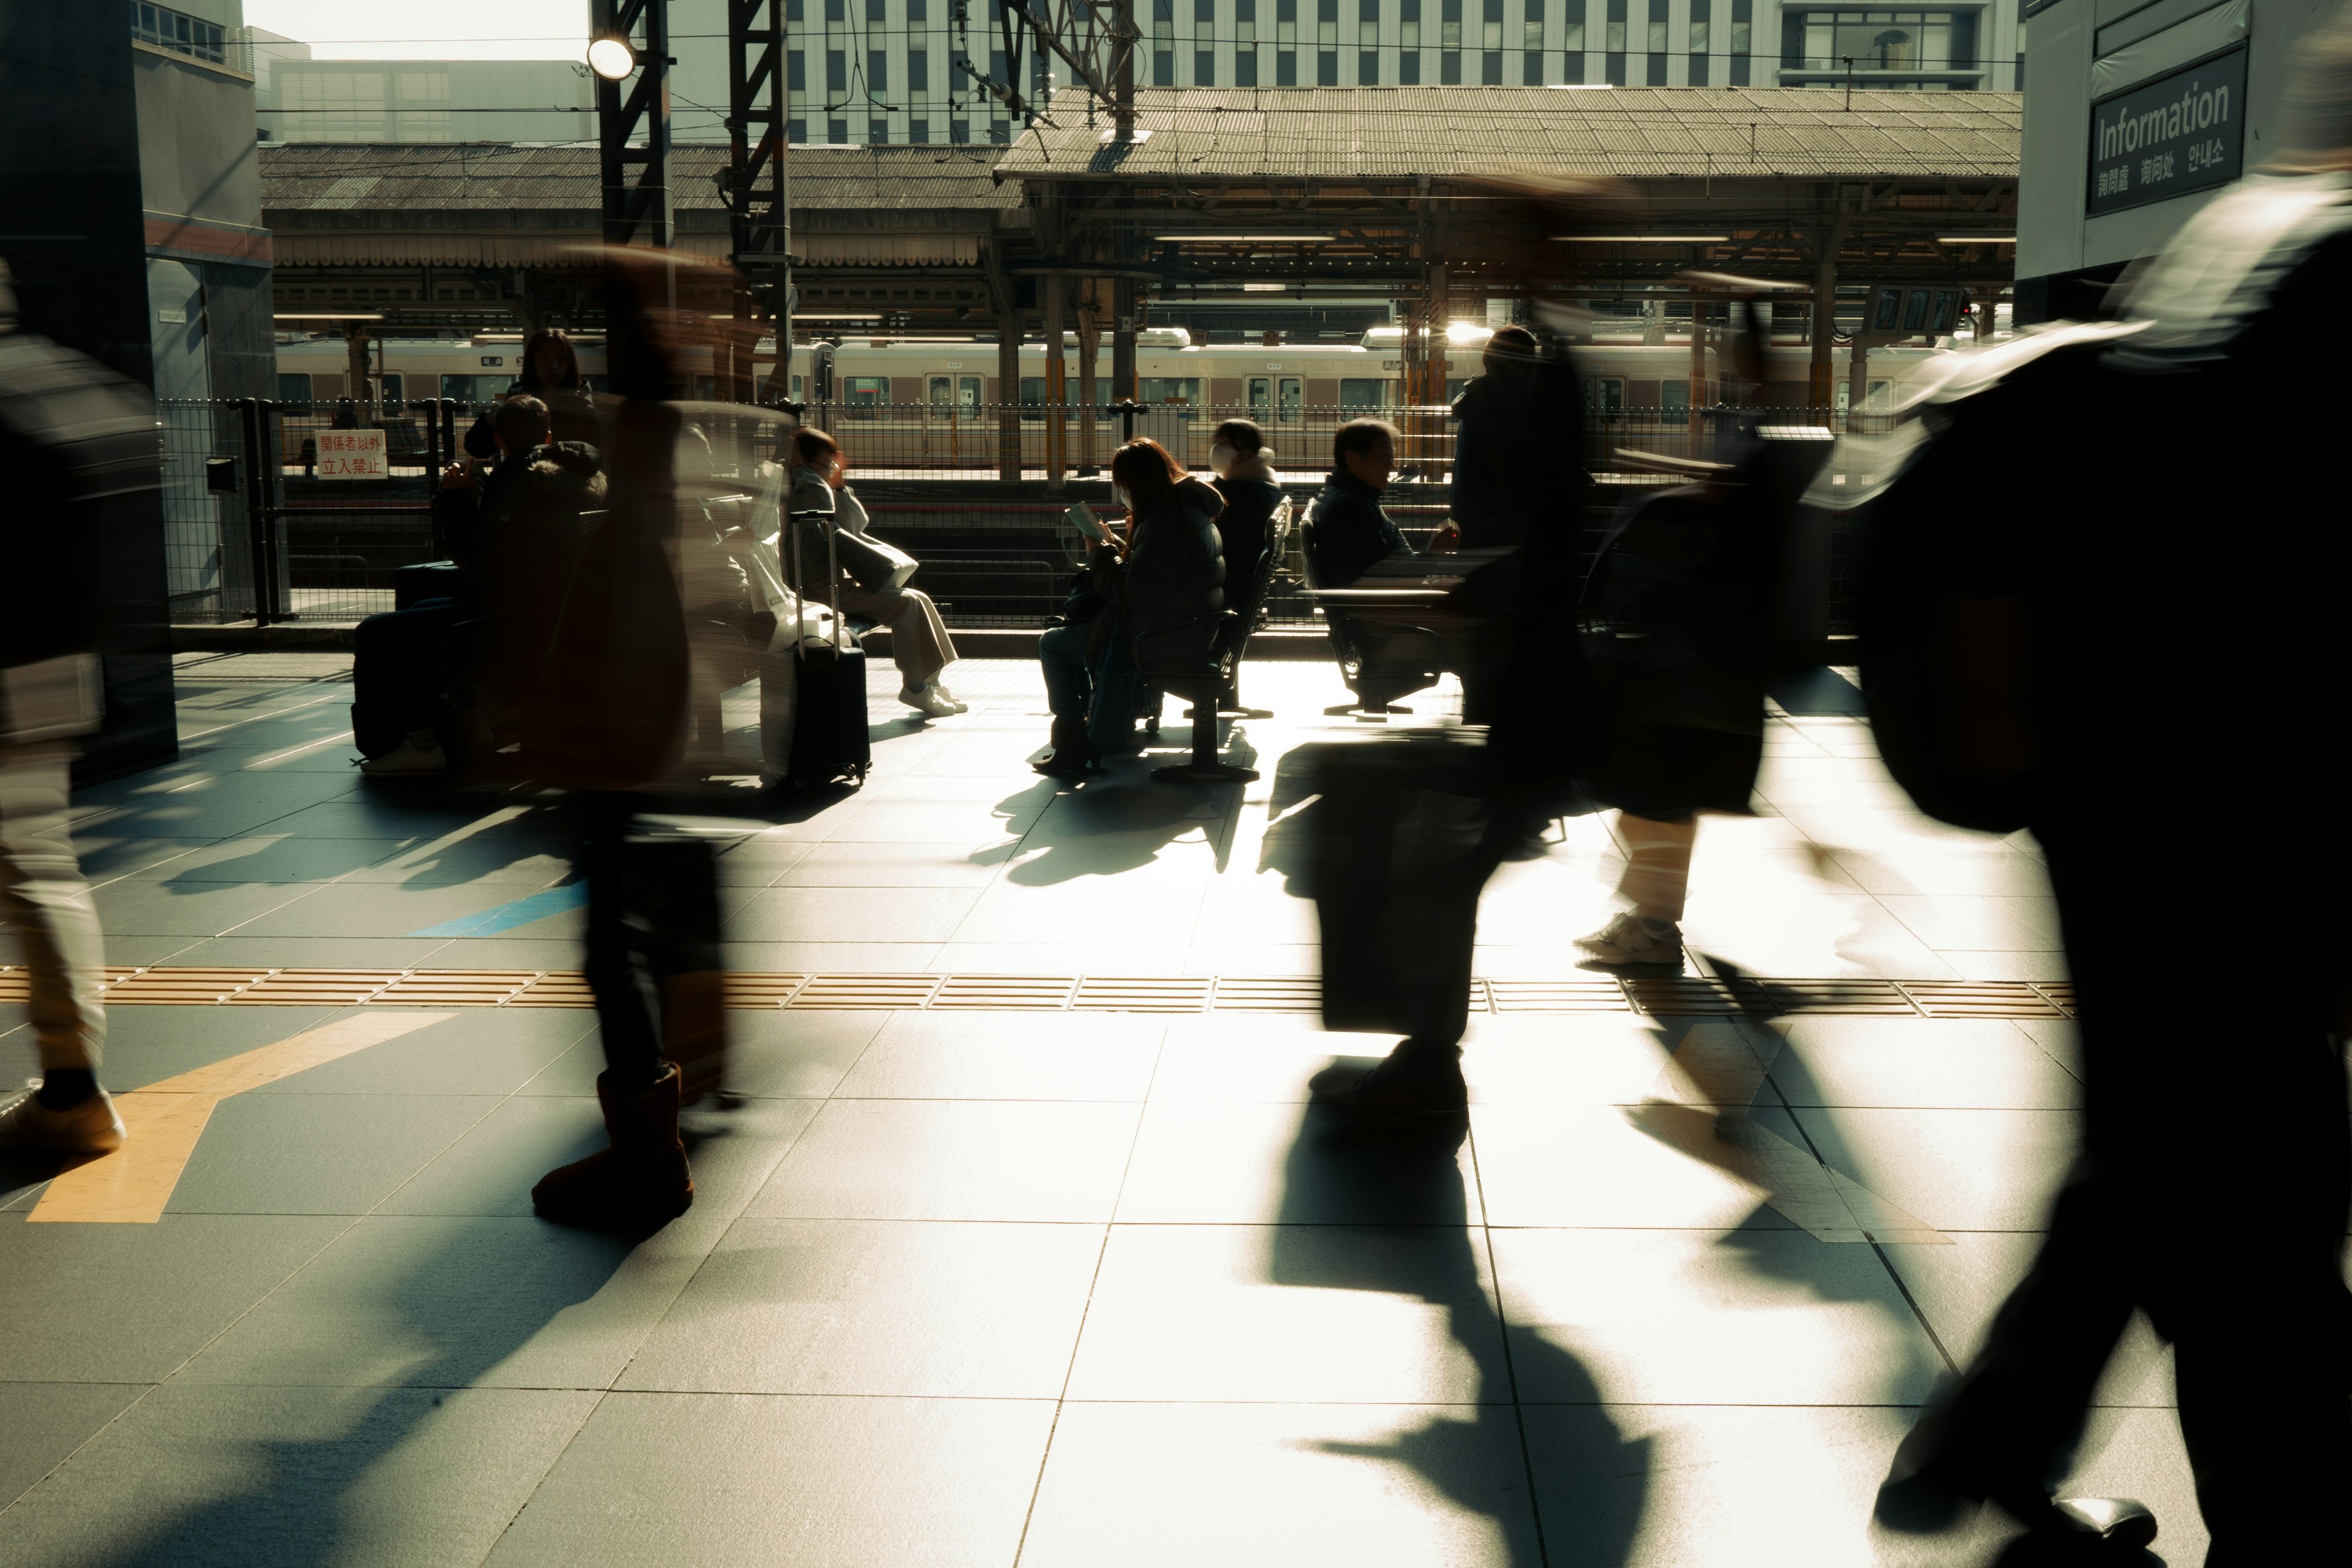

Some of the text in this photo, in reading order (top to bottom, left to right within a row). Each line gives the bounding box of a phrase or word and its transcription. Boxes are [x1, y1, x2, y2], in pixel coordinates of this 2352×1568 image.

[2098, 81, 2229, 161] Information
[2098, 138, 2223, 197] 詢問處 询问处 안내소
[321, 435, 380, 451] 関係者以外
[323, 458, 382, 474] 立入禁止
